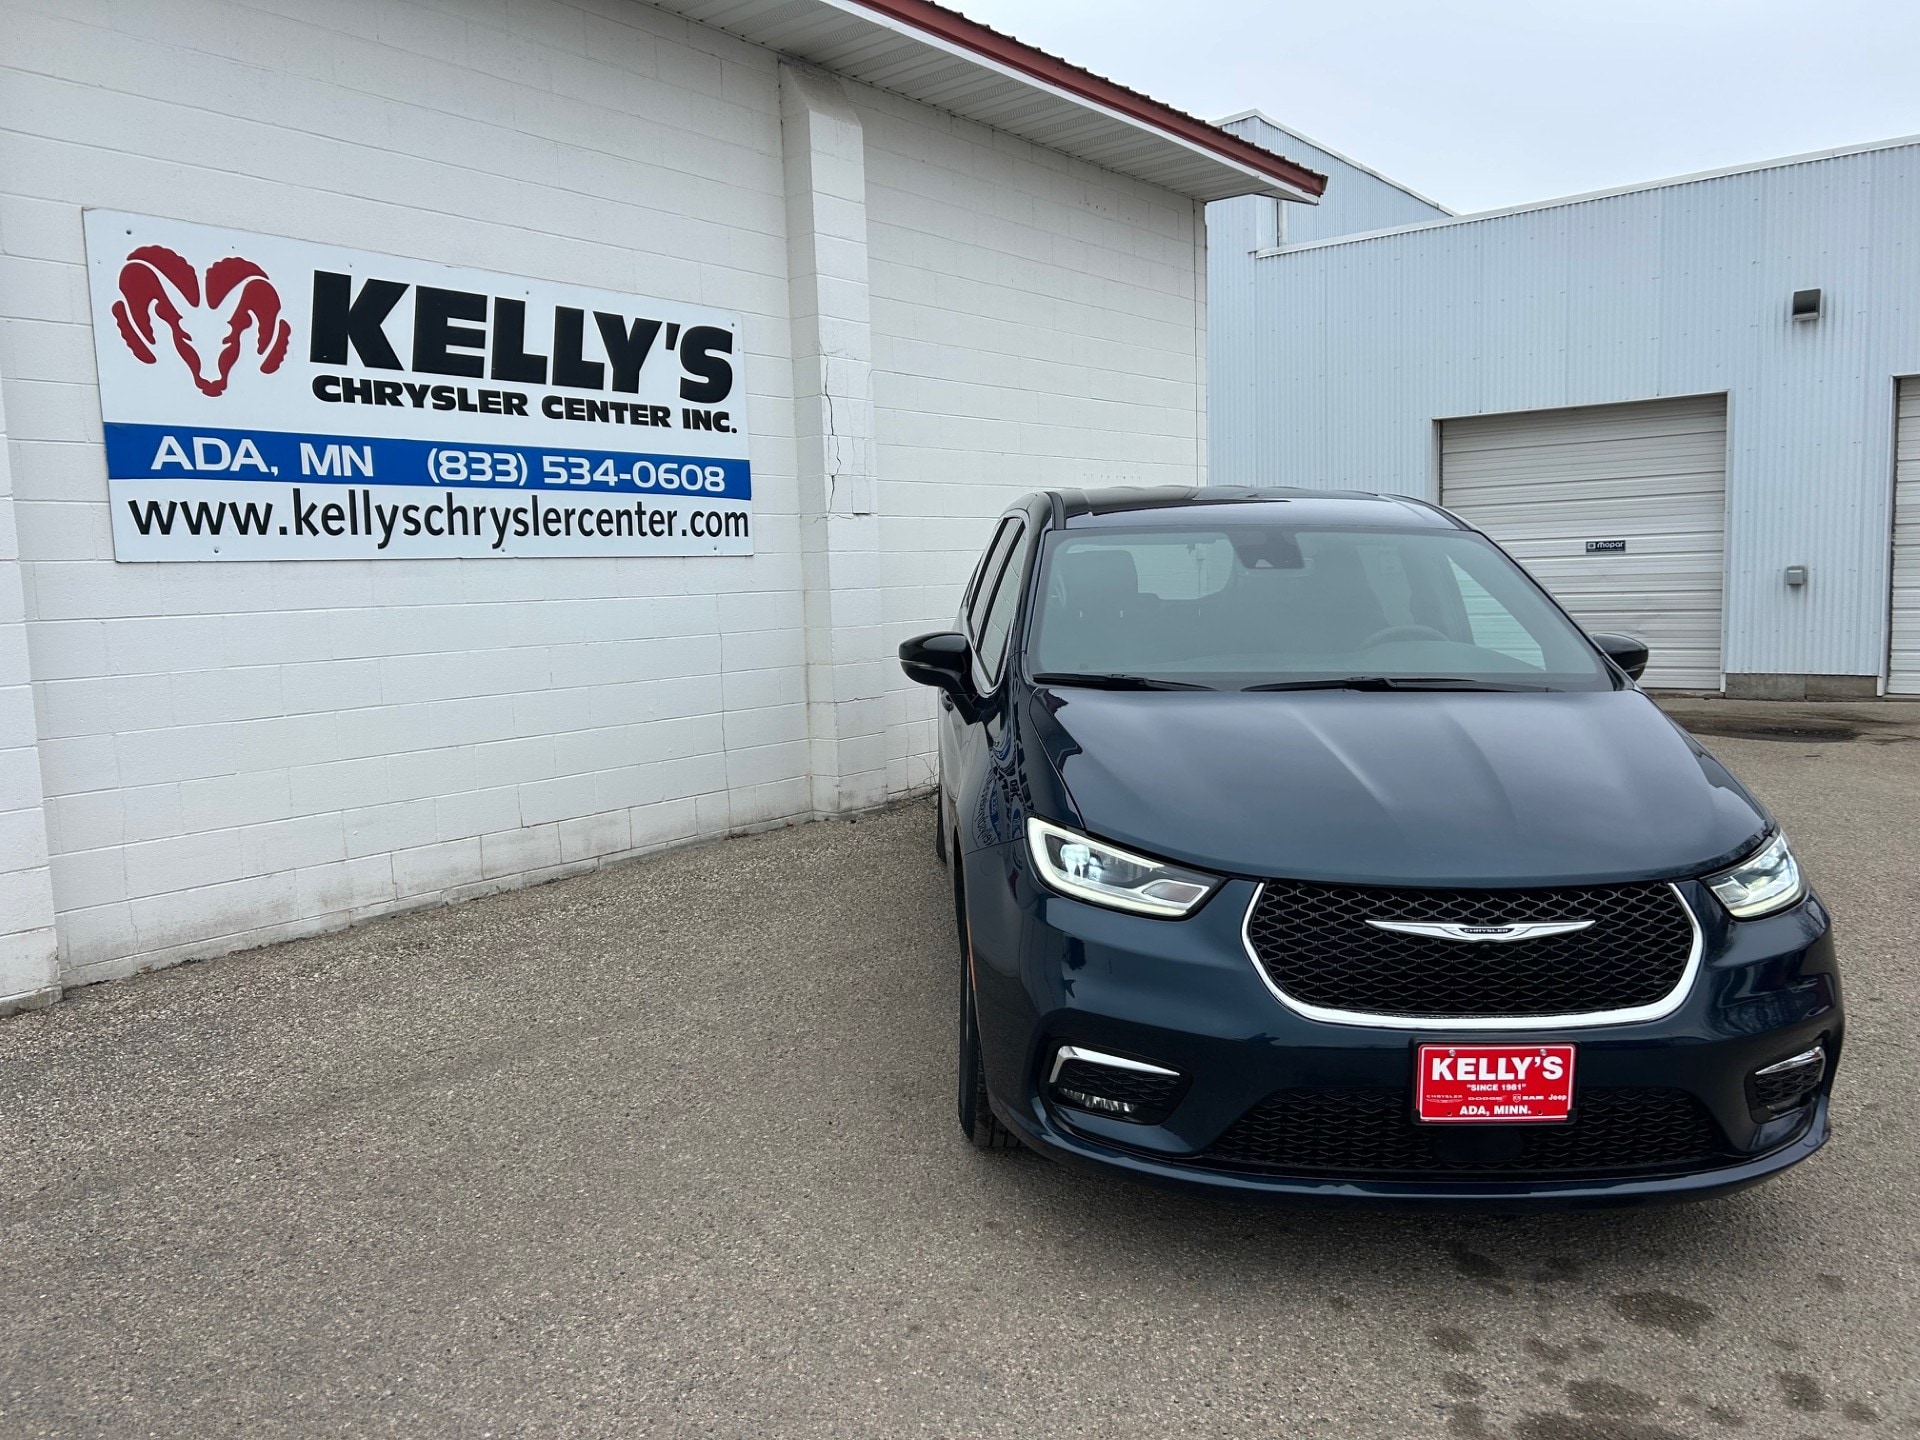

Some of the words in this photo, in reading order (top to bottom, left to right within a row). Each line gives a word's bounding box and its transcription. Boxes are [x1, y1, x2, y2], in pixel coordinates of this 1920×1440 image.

[310, 269, 734, 404] KELLY'S
[311, 374, 529, 417] CHRYSLER
[542, 395, 671, 429] CENTER
[682, 408, 738, 434] INC.
[151, 435, 279, 477] ADA,
[301, 443, 373, 477] MN
[426, 448, 528, 487] (833)
[543, 455, 726, 492] 534-0608
[127, 489, 749, 550] www.kellyschryslercenter.com
[1431, 1056, 1564, 1081] KELLY'S
[1459, 1105, 1490, 1117] ADA,
[1494, 1105, 1532, 1115] MINN.
